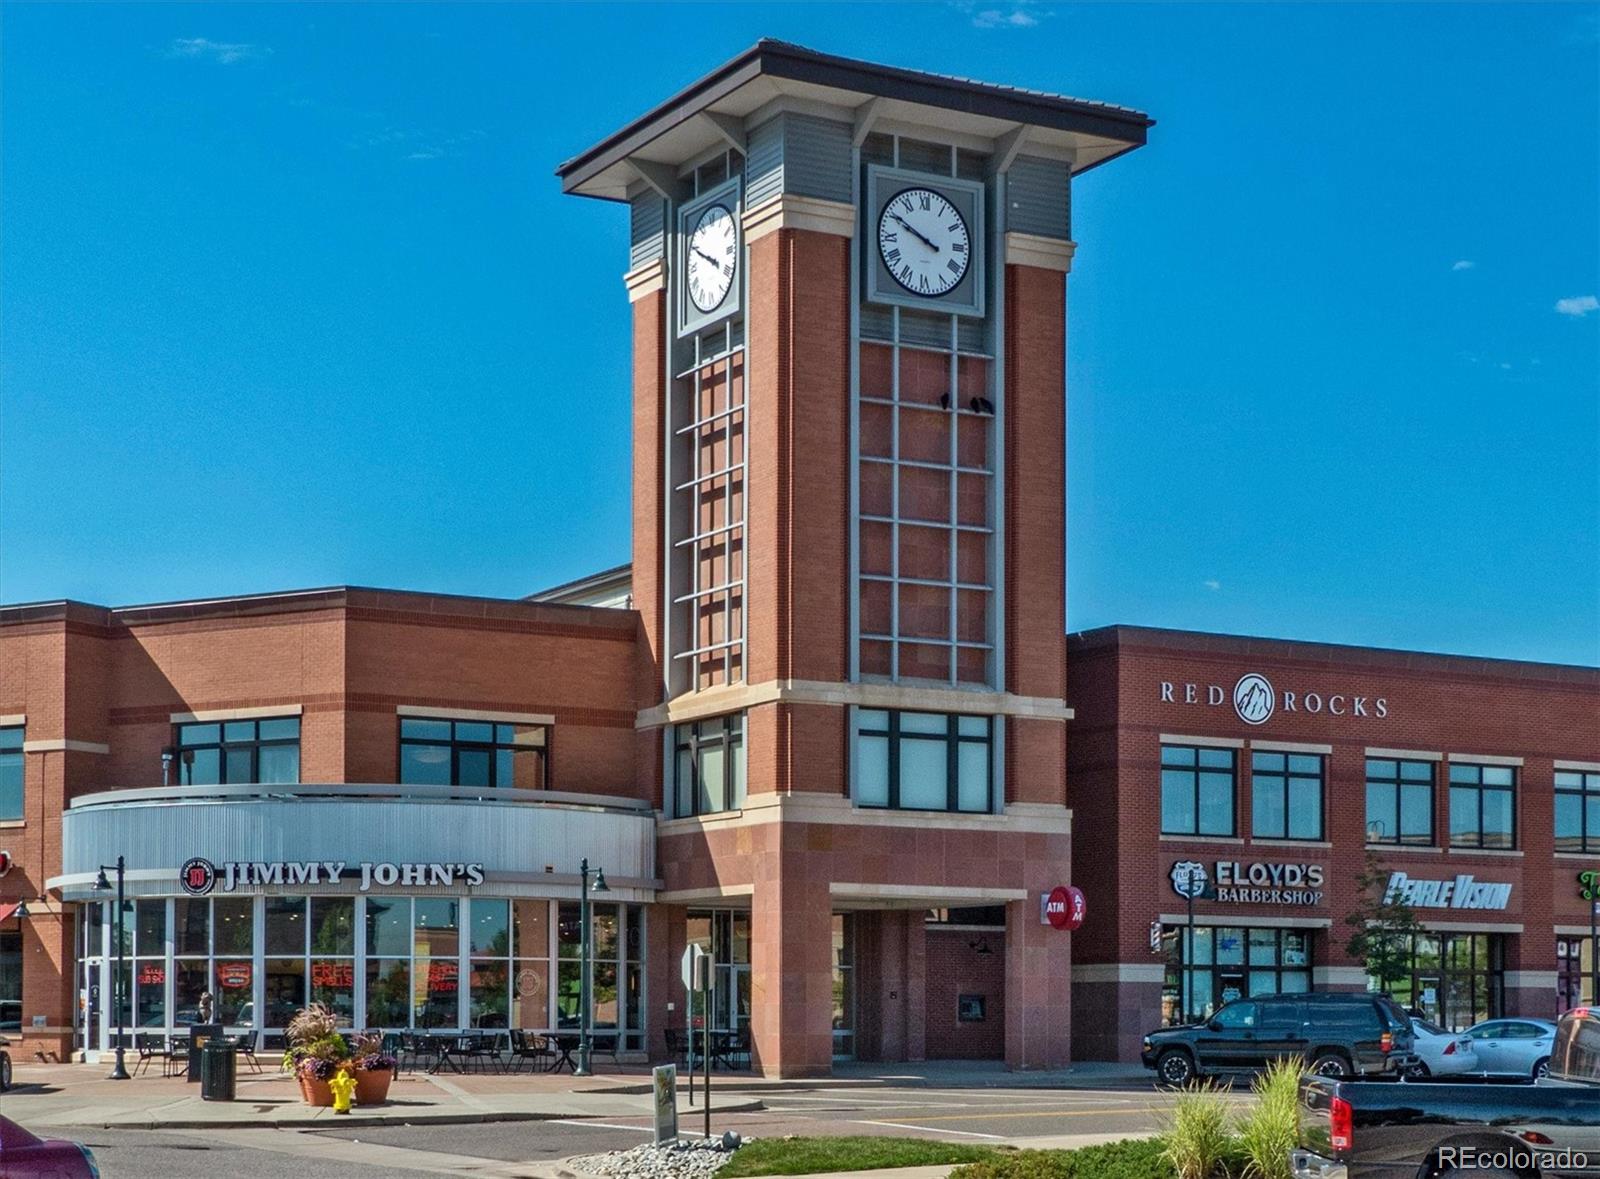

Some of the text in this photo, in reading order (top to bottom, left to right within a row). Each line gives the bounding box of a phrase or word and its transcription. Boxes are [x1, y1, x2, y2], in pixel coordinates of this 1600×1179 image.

[1159, 681, 1388, 718] RED ROCKS
[224, 861, 484, 892] JIMMY JOHN'S
[1046, 902, 1065, 913] ATM
[1072, 894, 1082, 921] ATM
[1217, 887, 1324, 906] BARBERSHOP
[312, 964, 353, 977] FREE
